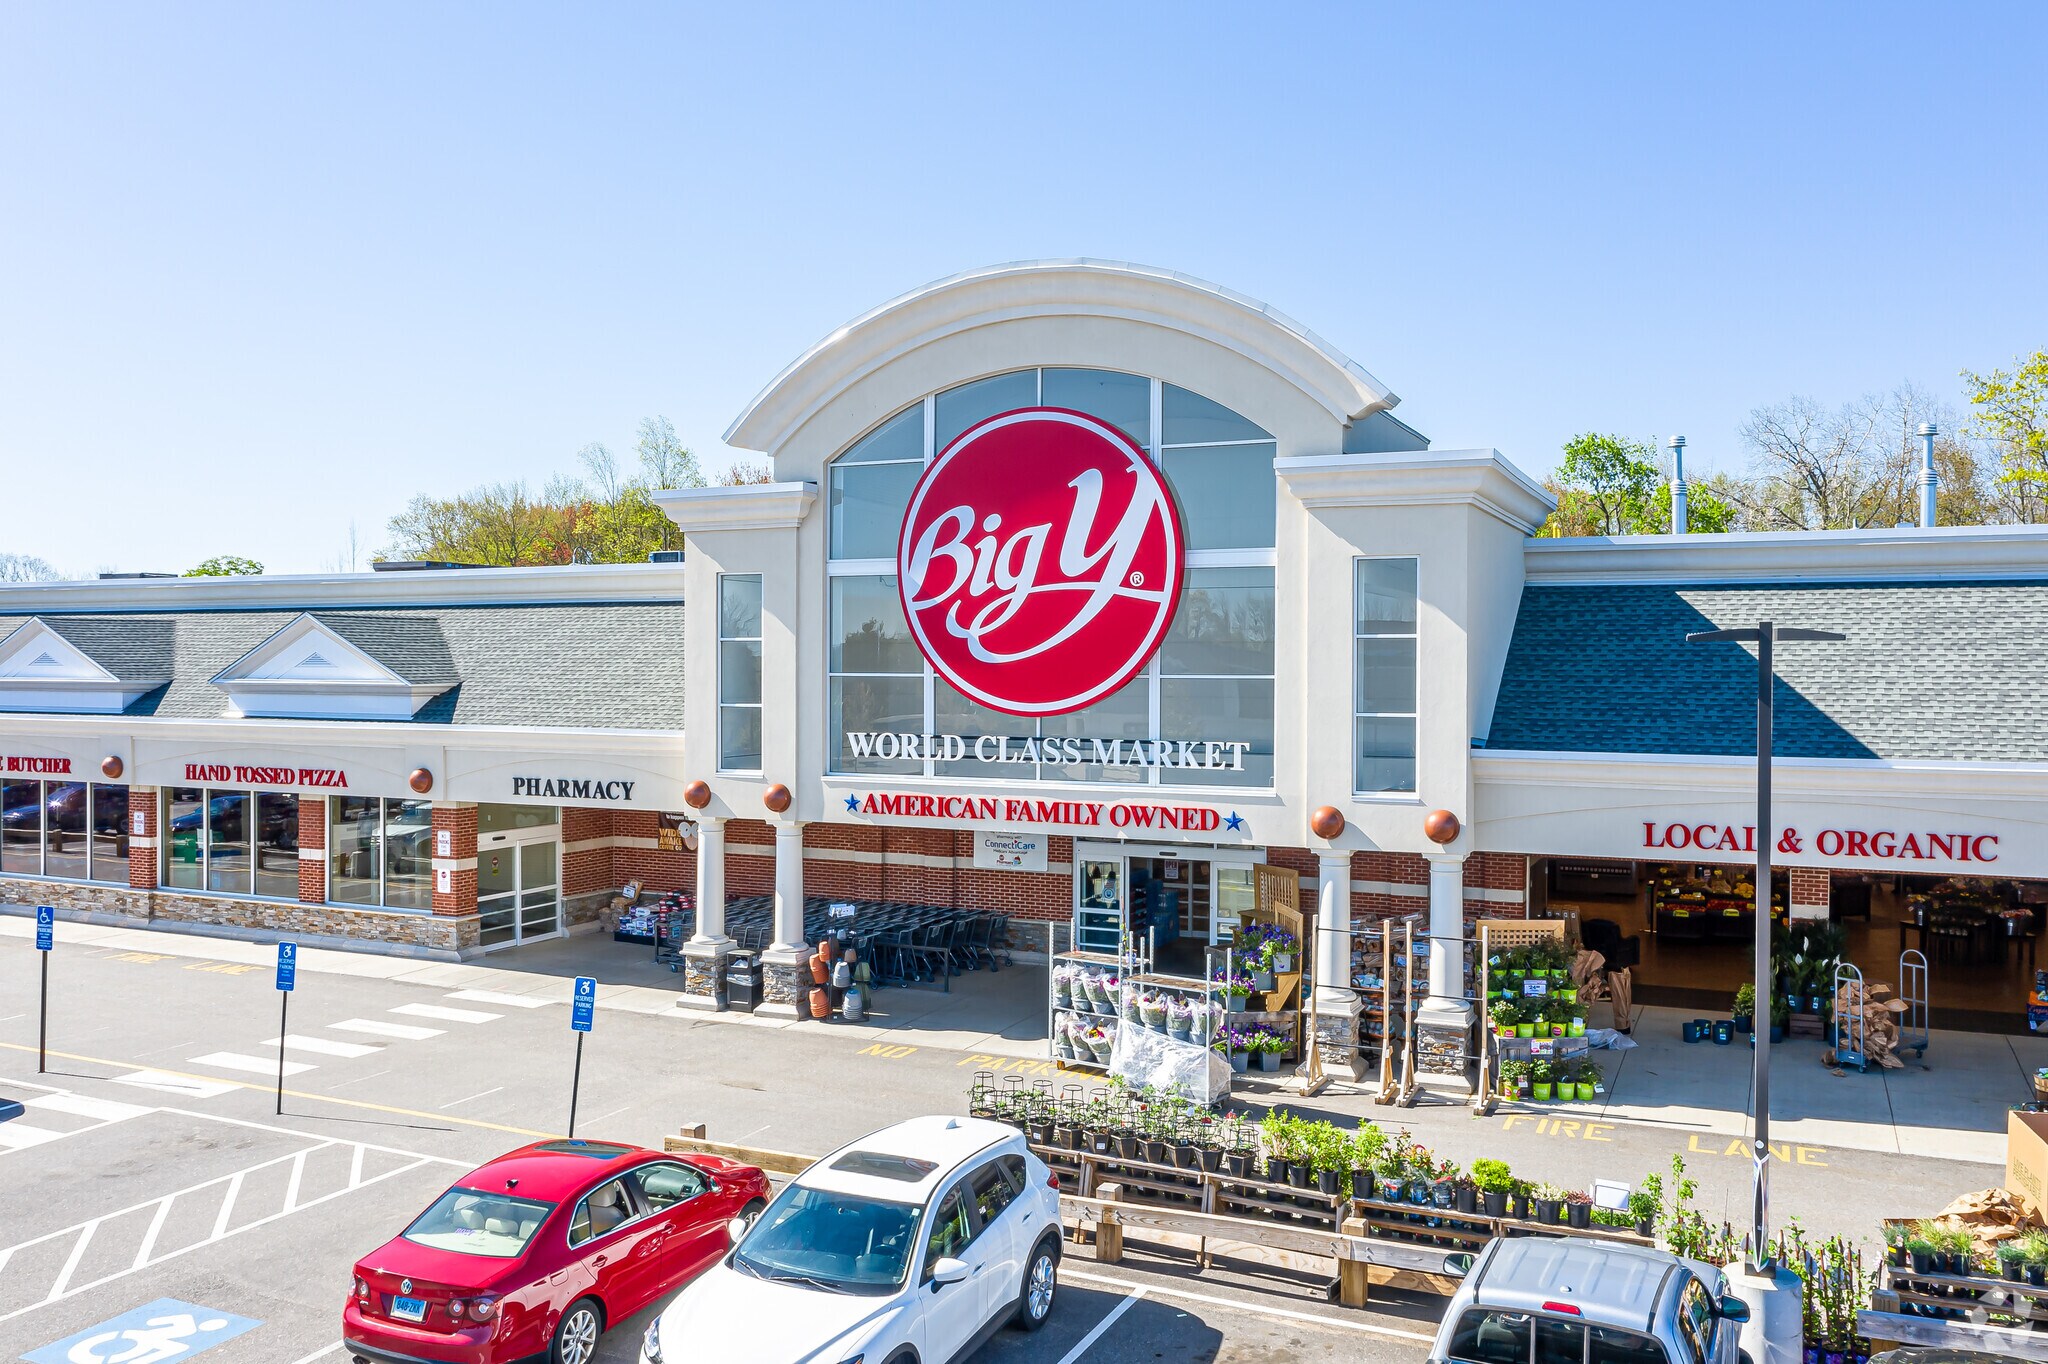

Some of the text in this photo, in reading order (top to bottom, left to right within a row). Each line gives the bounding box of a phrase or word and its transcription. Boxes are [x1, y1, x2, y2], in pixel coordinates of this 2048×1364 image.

[908, 505, 1053, 638] Big
[7, 757, 72, 774] BUTCHER
[847, 732, 1250, 771] WORLD CLASS MARKET
[185, 764, 348, 787] HAND TOSSED PIZZA
[512, 777, 635, 801] PHARMACY
[862, 793, 1219, 831] AMERICAN FAMILY OWNED
[985, 839, 1035, 849] ConnectiCare
[1777, 828, 1802, 854] &
[1816, 829, 1998, 862] ORGANIC
[857, 1043, 918, 1059] NO
[1502, 1115, 1829, 1167] FIRE LANE
